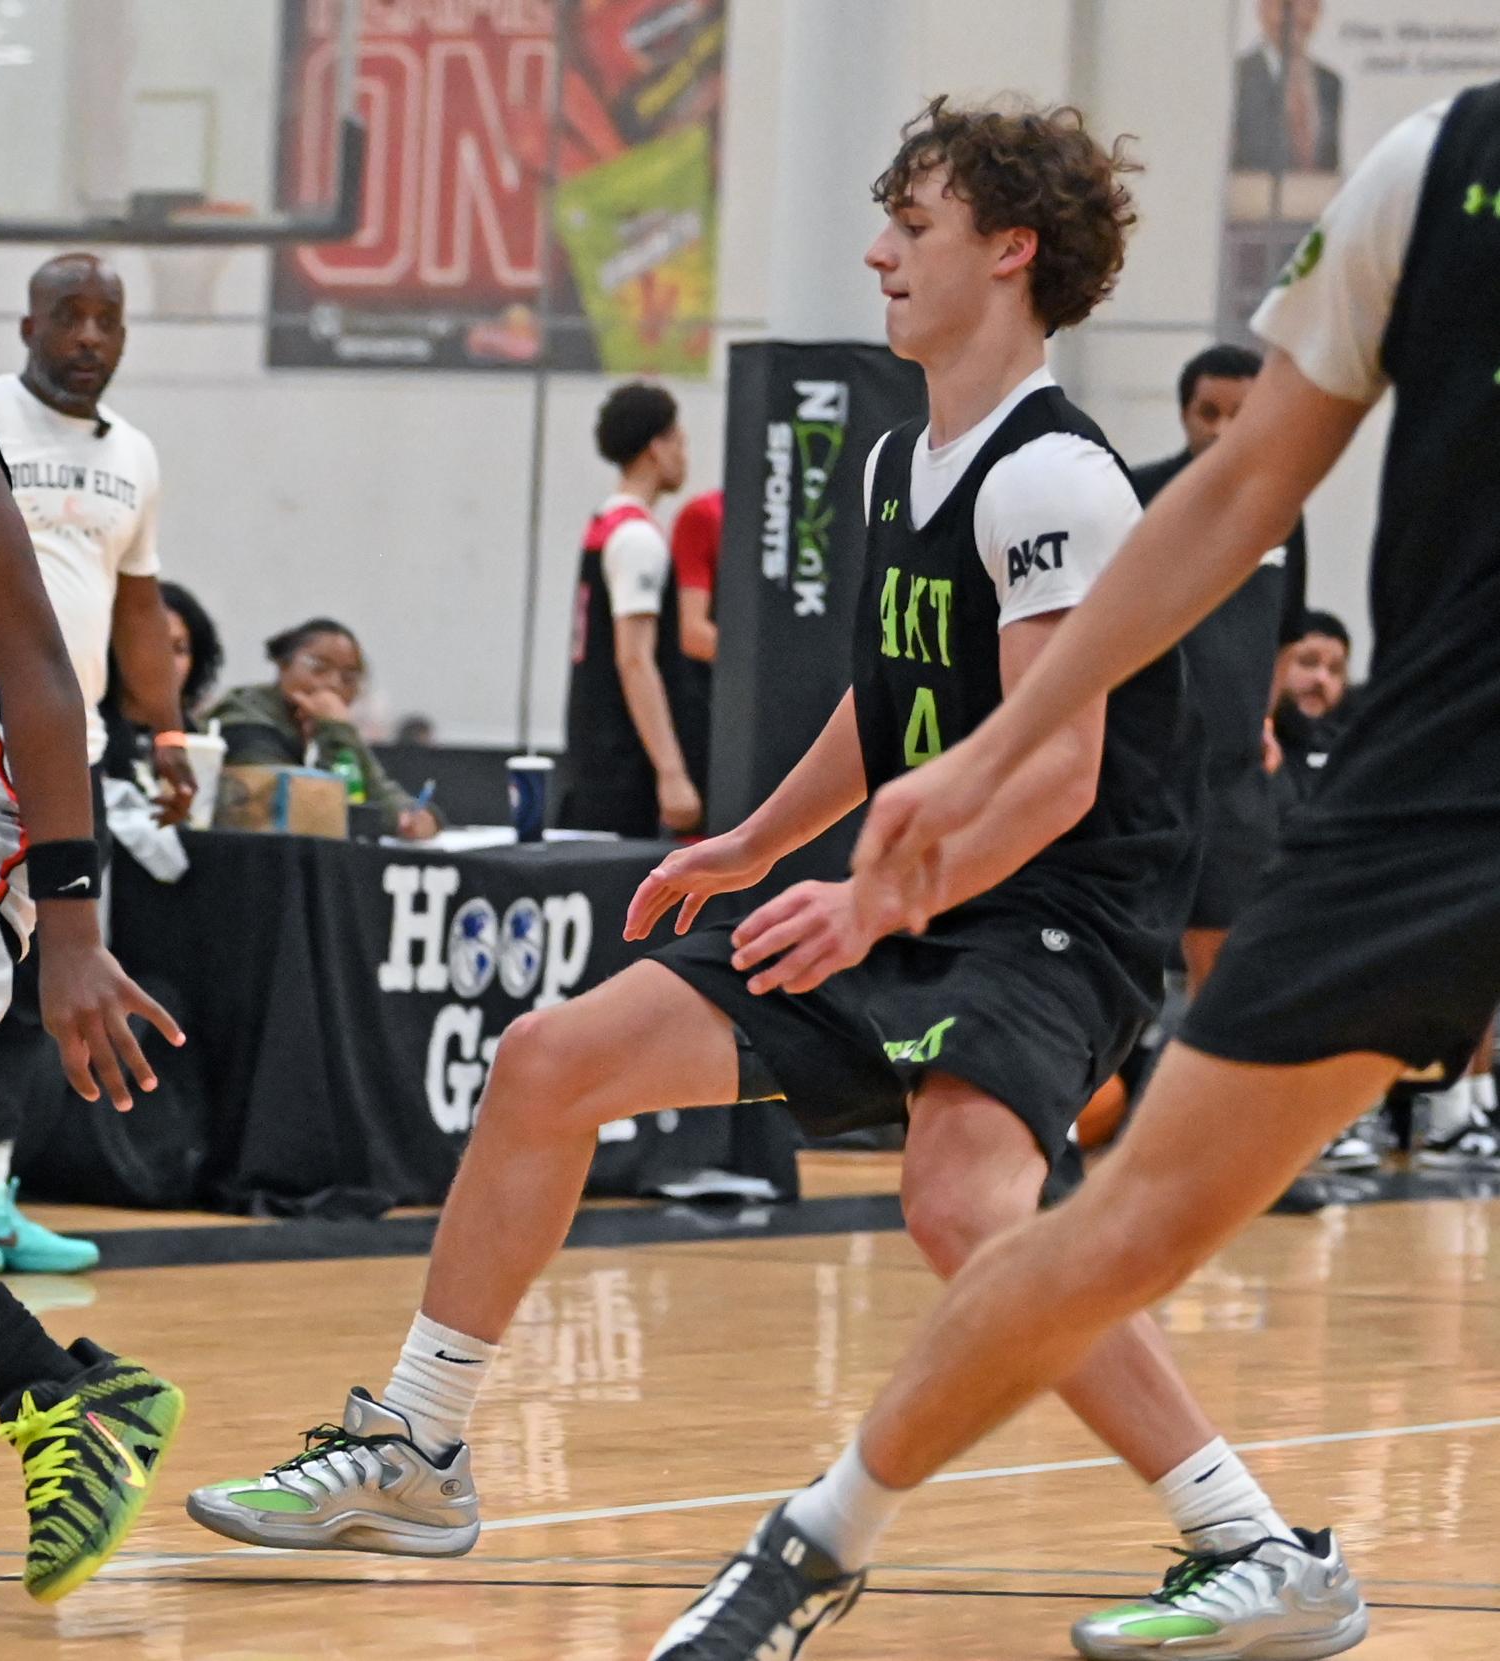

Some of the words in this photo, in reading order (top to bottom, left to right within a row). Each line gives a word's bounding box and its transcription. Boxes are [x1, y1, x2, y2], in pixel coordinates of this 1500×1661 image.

[297, 39, 556, 287] ON
[1007, 531, 1069, 587] AKT
[880, 566, 952, 668] AKT
[903, 687, 945, 767] 4
[378, 863, 593, 1010] Hoop
